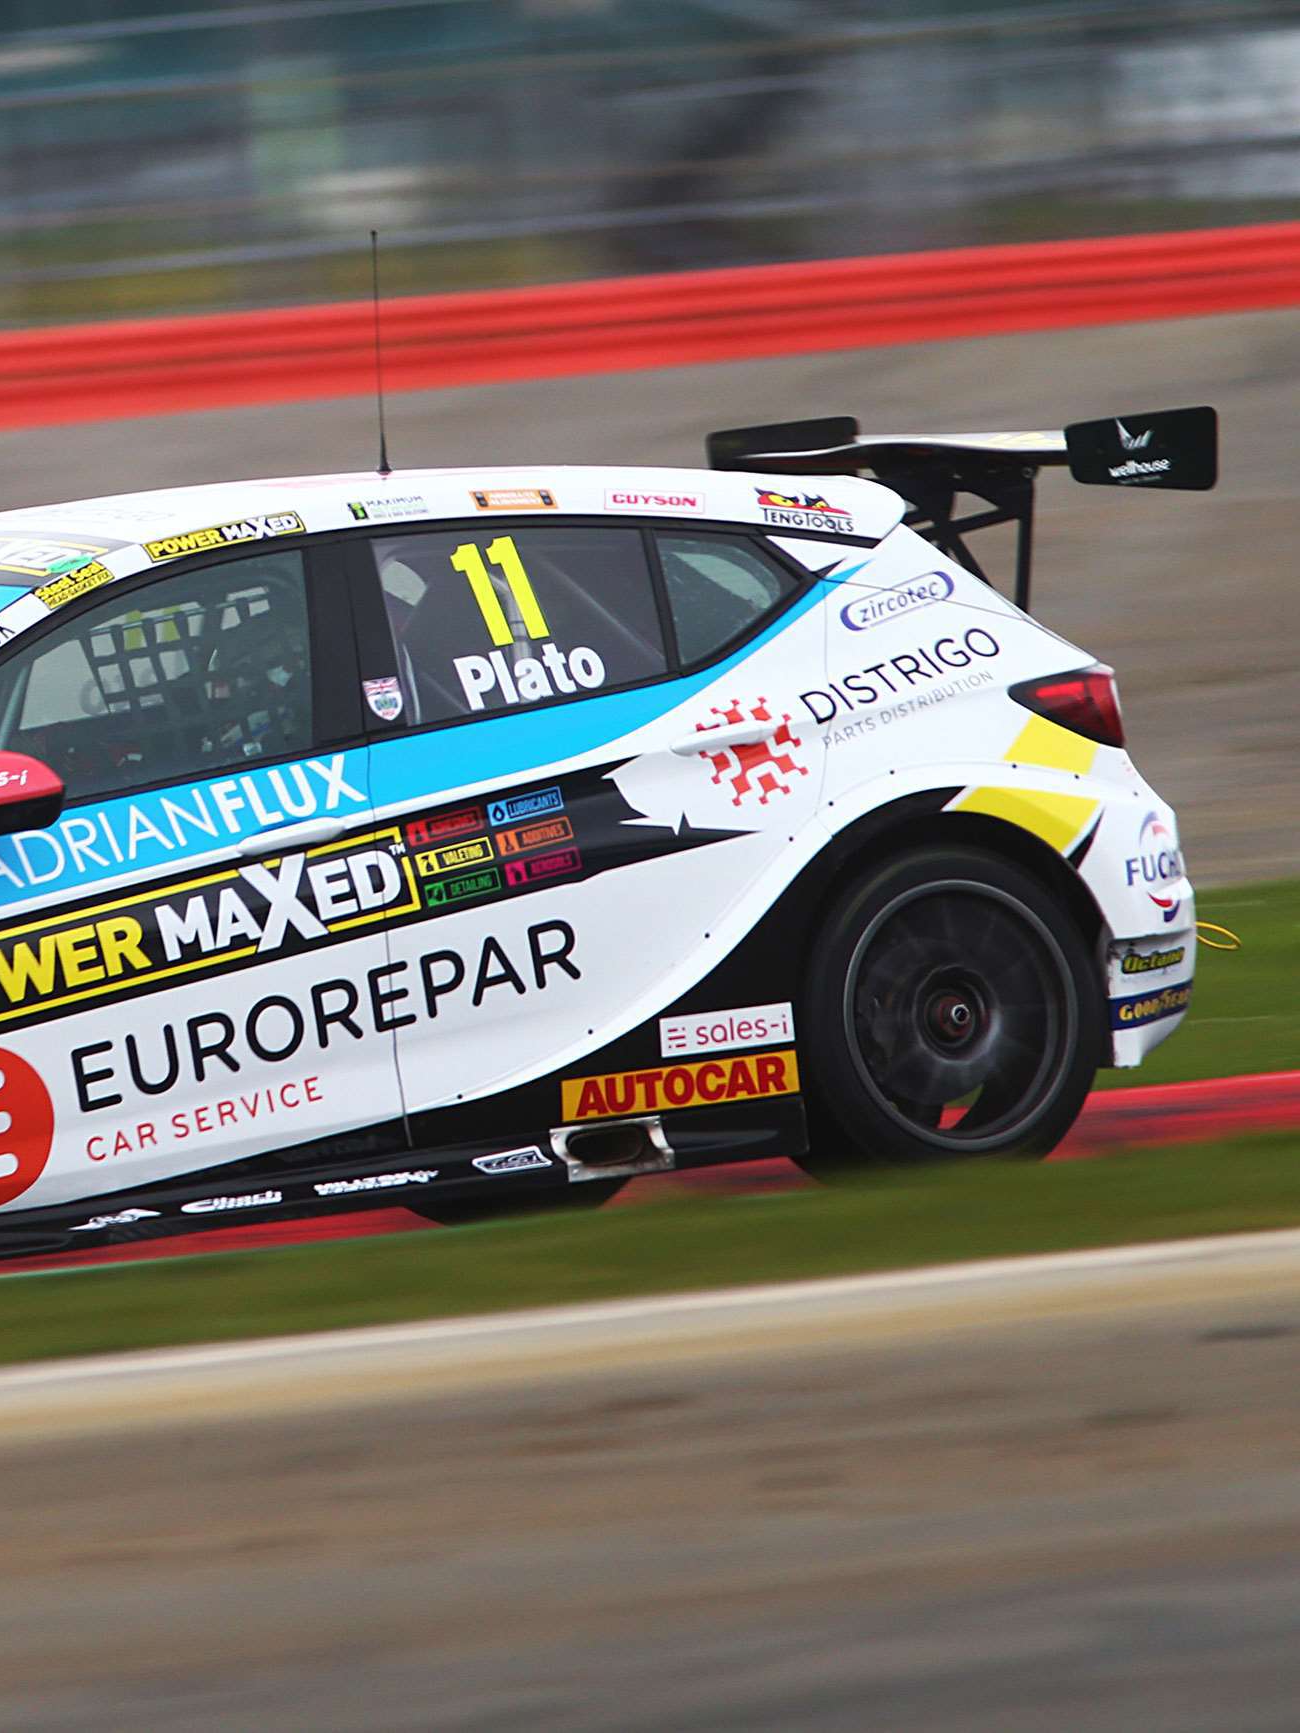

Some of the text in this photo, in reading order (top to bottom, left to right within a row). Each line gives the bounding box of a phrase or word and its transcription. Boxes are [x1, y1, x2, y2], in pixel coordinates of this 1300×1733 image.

[150, 514, 297, 557] POWER MAXED
[450, 536, 549, 647] 11
[859, 581, 939, 623] zircotec
[454, 641, 606, 711] Plato
[799, 628, 1000, 725] DISTRIGO
[822, 670, 994, 750] PARTS DISTRIBUTION
[442, 843, 484, 866] VALETING
[450, 874, 494, 896] DETAILING
[1125, 850, 1182, 886] FUCH
[155, 852, 403, 962] MAXED
[69, 919, 582, 1112] EUROREPAR
[695, 1014, 788, 1047] sales-i
[87, 1076, 325, 1162] CAR SERVICE
[576, 1055, 788, 1118] AUTOCAR
